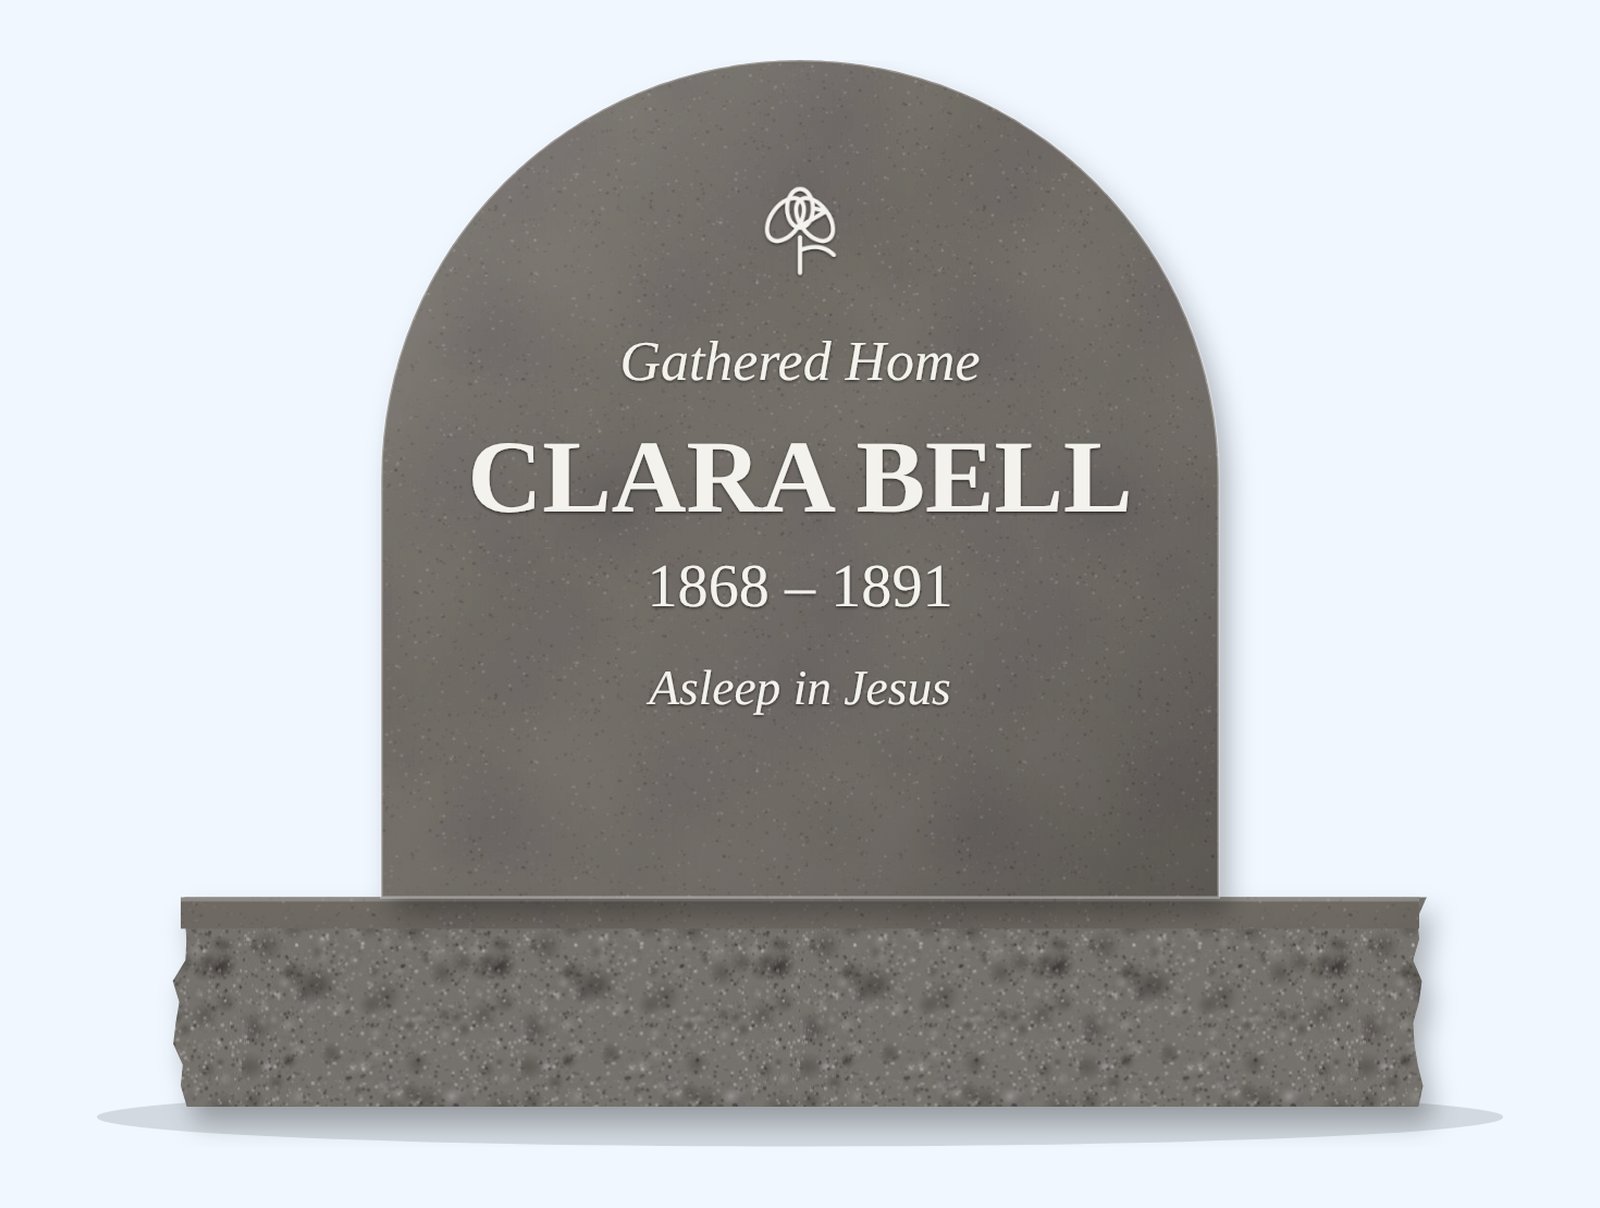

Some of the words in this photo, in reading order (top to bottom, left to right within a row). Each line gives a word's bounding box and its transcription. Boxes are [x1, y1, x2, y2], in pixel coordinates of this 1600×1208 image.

[621, 340, 832, 382] Gathered
[844, 342, 980, 382] Home
[471, 442, 836, 514] CLARA
[857, 443, 1129, 513] BELL
[650, 564, 768, 608] 1868
[834, 564, 951, 608] 1891
[647, 669, 780, 716] Asleep
[794, 671, 830, 706] in
[844, 671, 950, 706] Jesus
